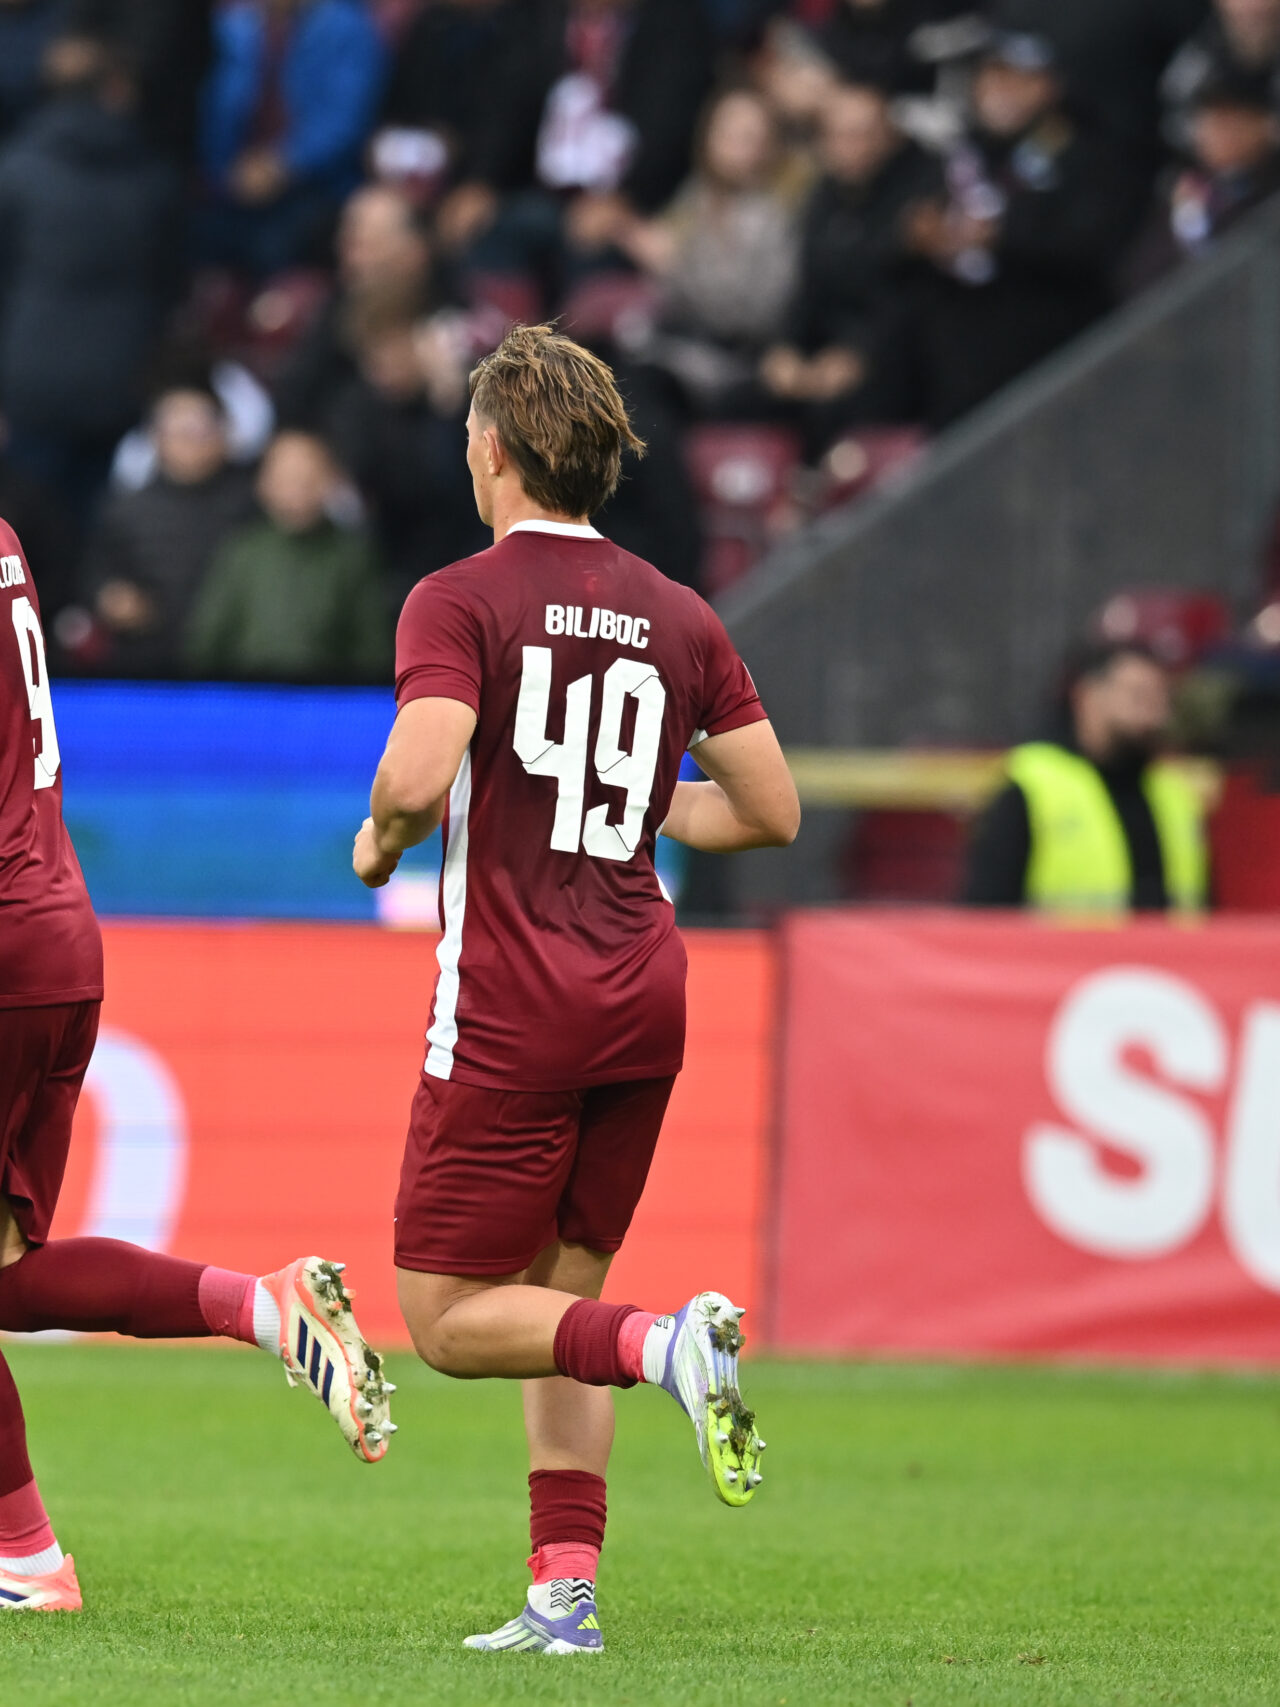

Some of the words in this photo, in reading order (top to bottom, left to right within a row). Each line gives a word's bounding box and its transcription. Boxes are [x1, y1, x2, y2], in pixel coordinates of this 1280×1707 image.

[11, 595, 61, 791] 9
[544, 603, 651, 650] BILIBOC
[512, 644, 667, 863] 49
